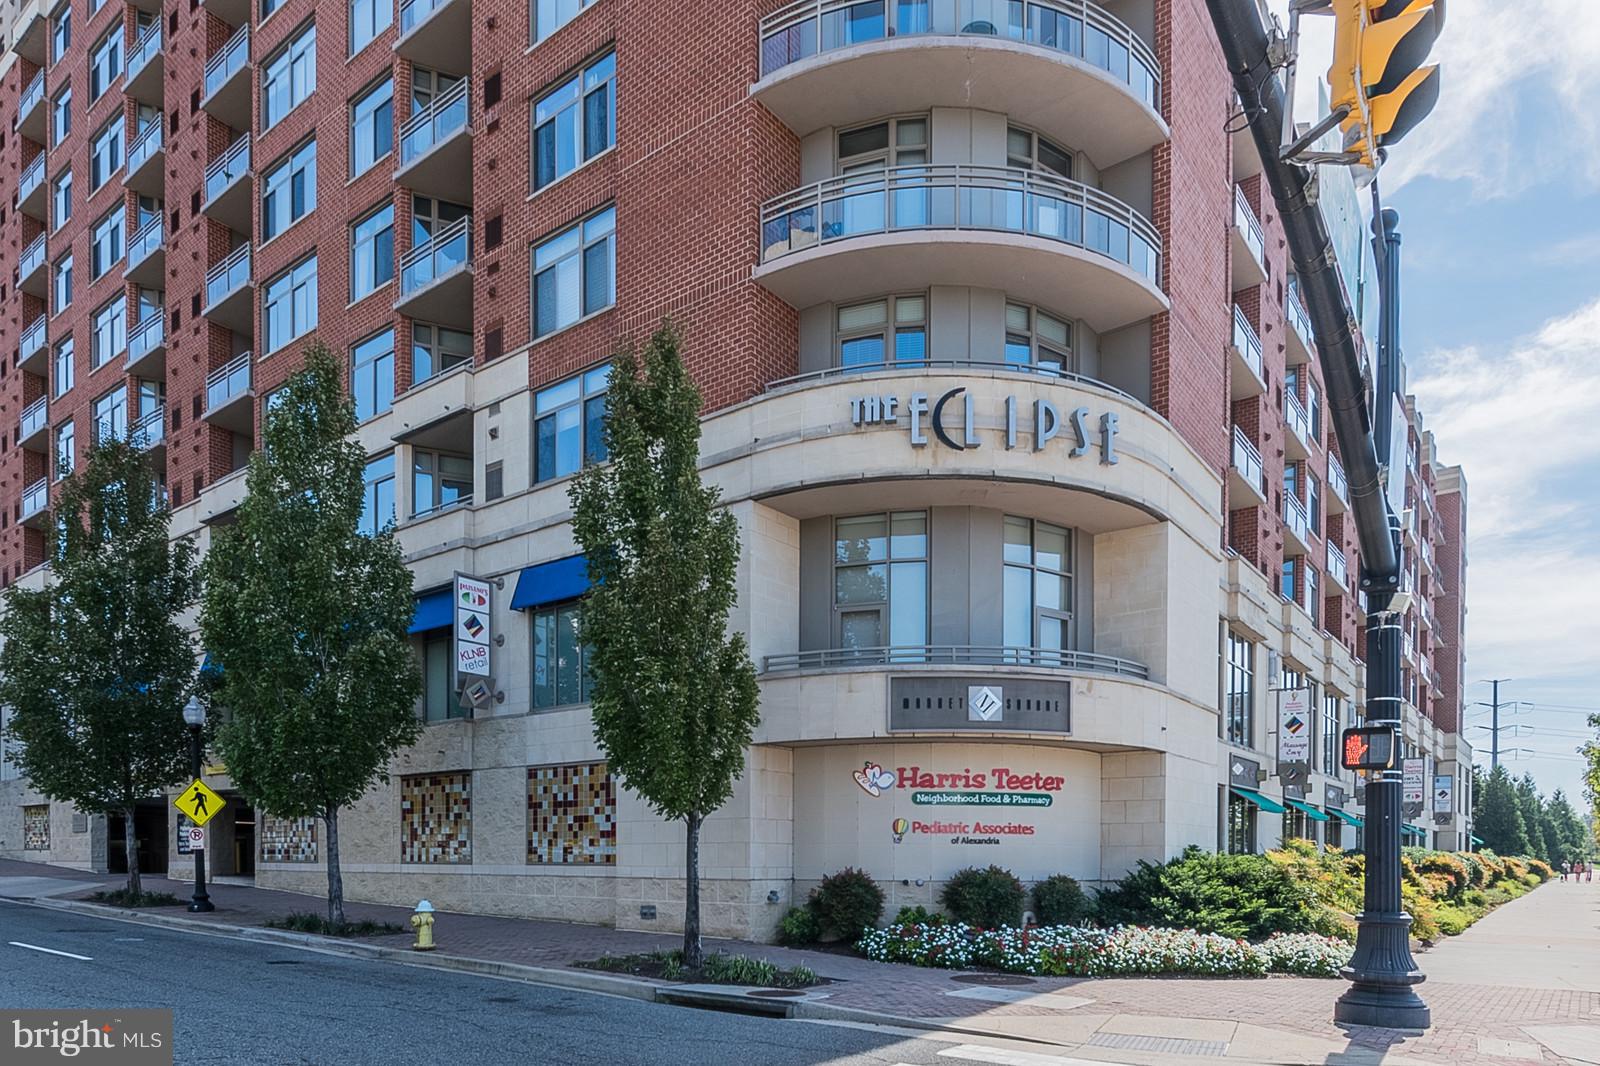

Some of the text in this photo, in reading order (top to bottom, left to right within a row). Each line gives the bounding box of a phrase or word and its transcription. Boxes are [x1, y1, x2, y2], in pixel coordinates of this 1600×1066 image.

[851, 386, 1119, 466] THE ECLIPSE
[460, 647, 487, 661] KLNB
[465, 657, 489, 671] retail
[896, 766, 1065, 791] Harris Teeter
[916, 793, 1050, 807] Neighborhood Food & Pharmacy
[912, 821, 1035, 835] Pediatric Associates
[951, 837, 1000, 845] of Alexandria
